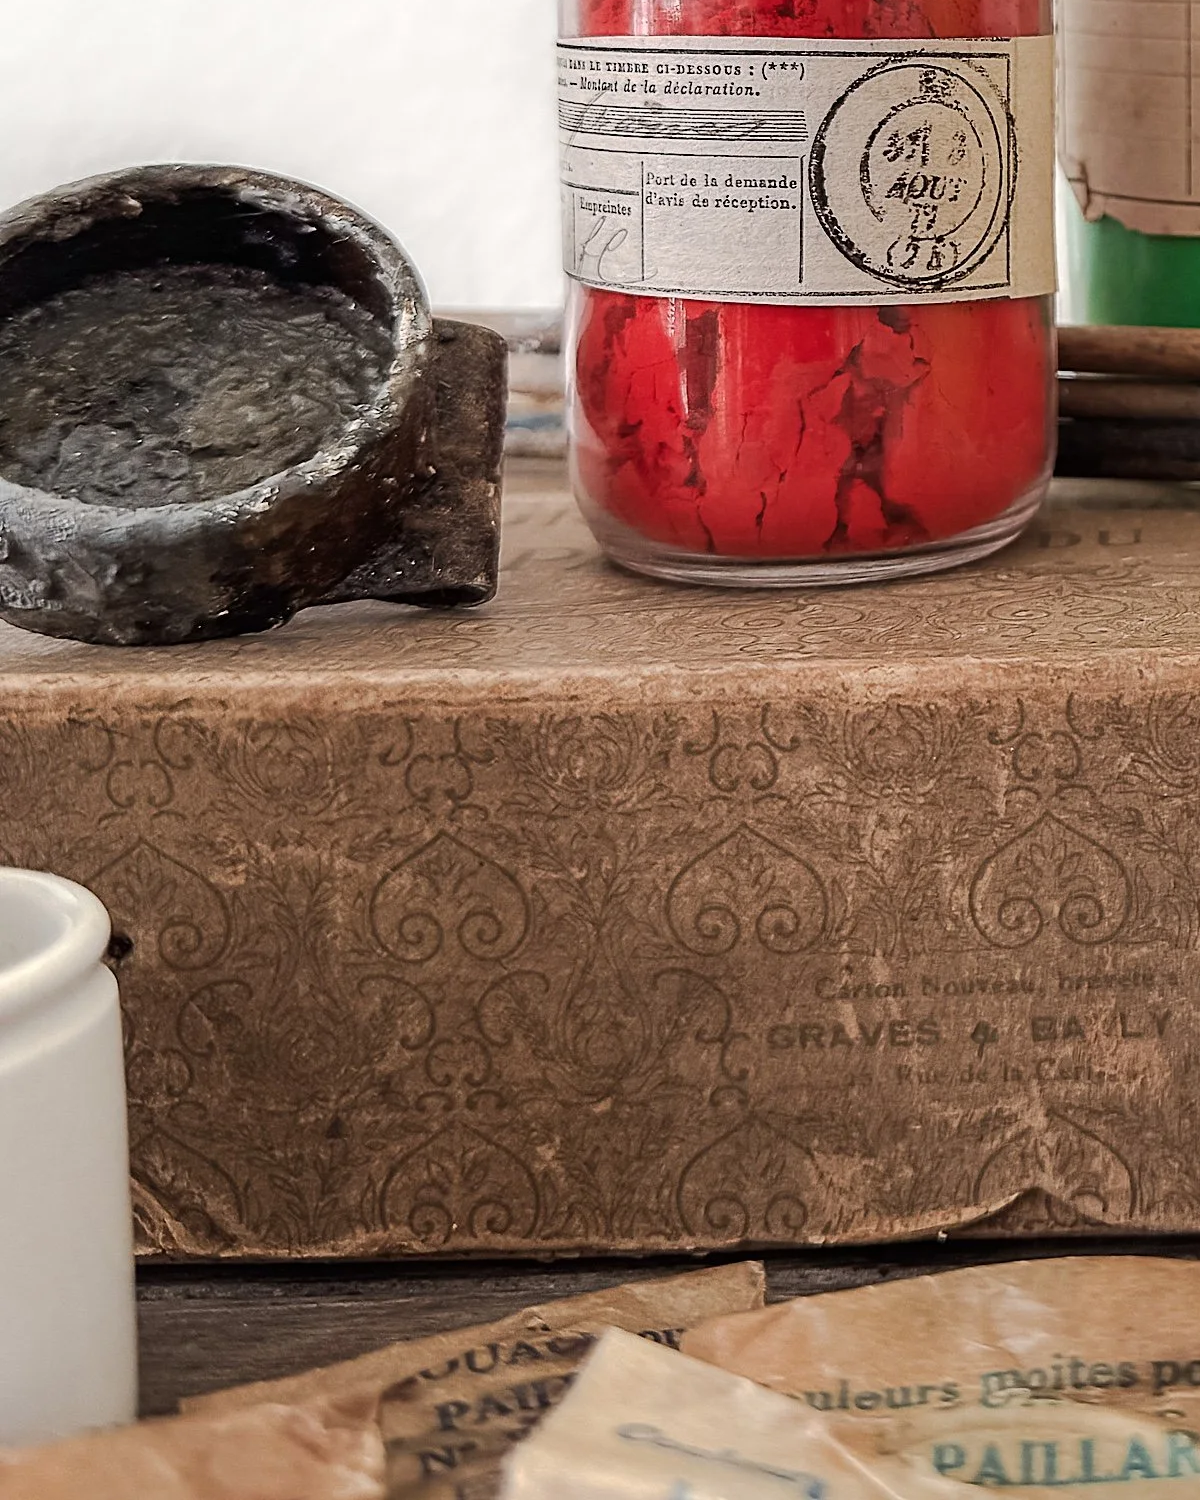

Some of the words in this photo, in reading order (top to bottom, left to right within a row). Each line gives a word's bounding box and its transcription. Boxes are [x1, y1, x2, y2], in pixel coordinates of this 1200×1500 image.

[589, 60, 602, 72] LE
[606, 62, 649, 74] TIMBRE
[656, 63, 742, 76] CI-DESSOUS
[623, 78, 637, 94] de
[643, 79, 657, 94] la
[664, 80, 761, 98] déclaration.
[646, 172, 676, 186] Port
[680, 173, 697, 187] de
[704, 174, 718, 188] la
[724, 174, 798, 189] demande
[580, 196, 632, 217] Empreintes
[645, 191, 685, 207] d'avis
[691, 194, 709, 209] de
[714, 193, 797, 213] réception.
[766, 1016, 941, 1051] GRAVES
